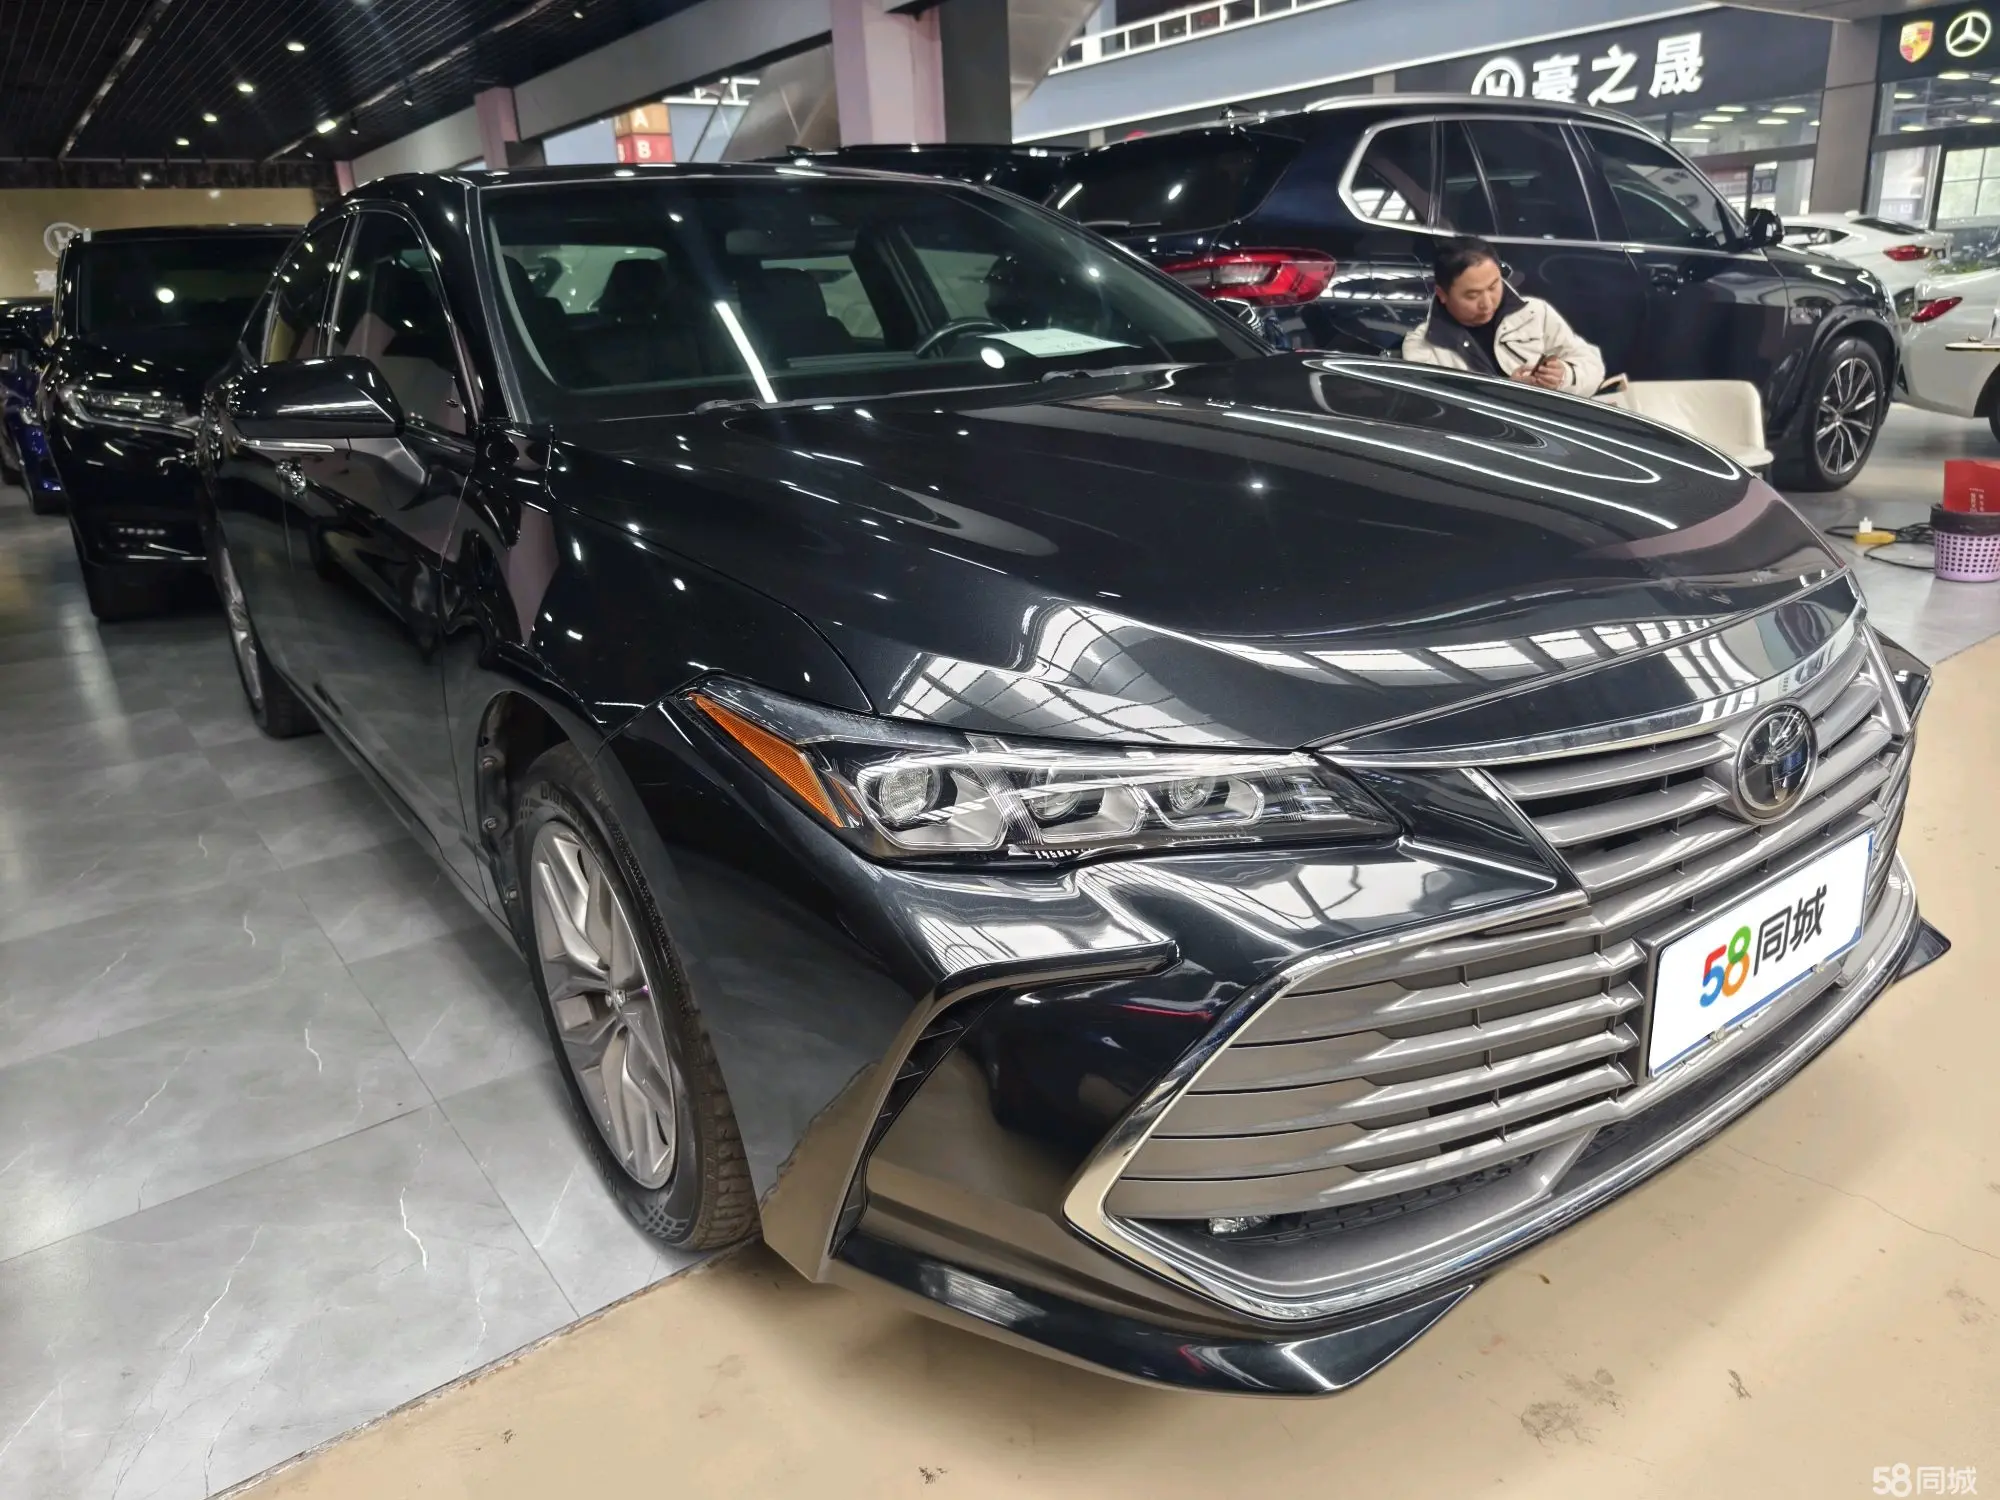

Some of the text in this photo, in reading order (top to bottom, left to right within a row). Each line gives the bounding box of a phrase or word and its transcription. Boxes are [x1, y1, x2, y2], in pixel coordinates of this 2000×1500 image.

[1532, 31, 1704, 107] 豪之晟
[637, 139, 652, 159] B
